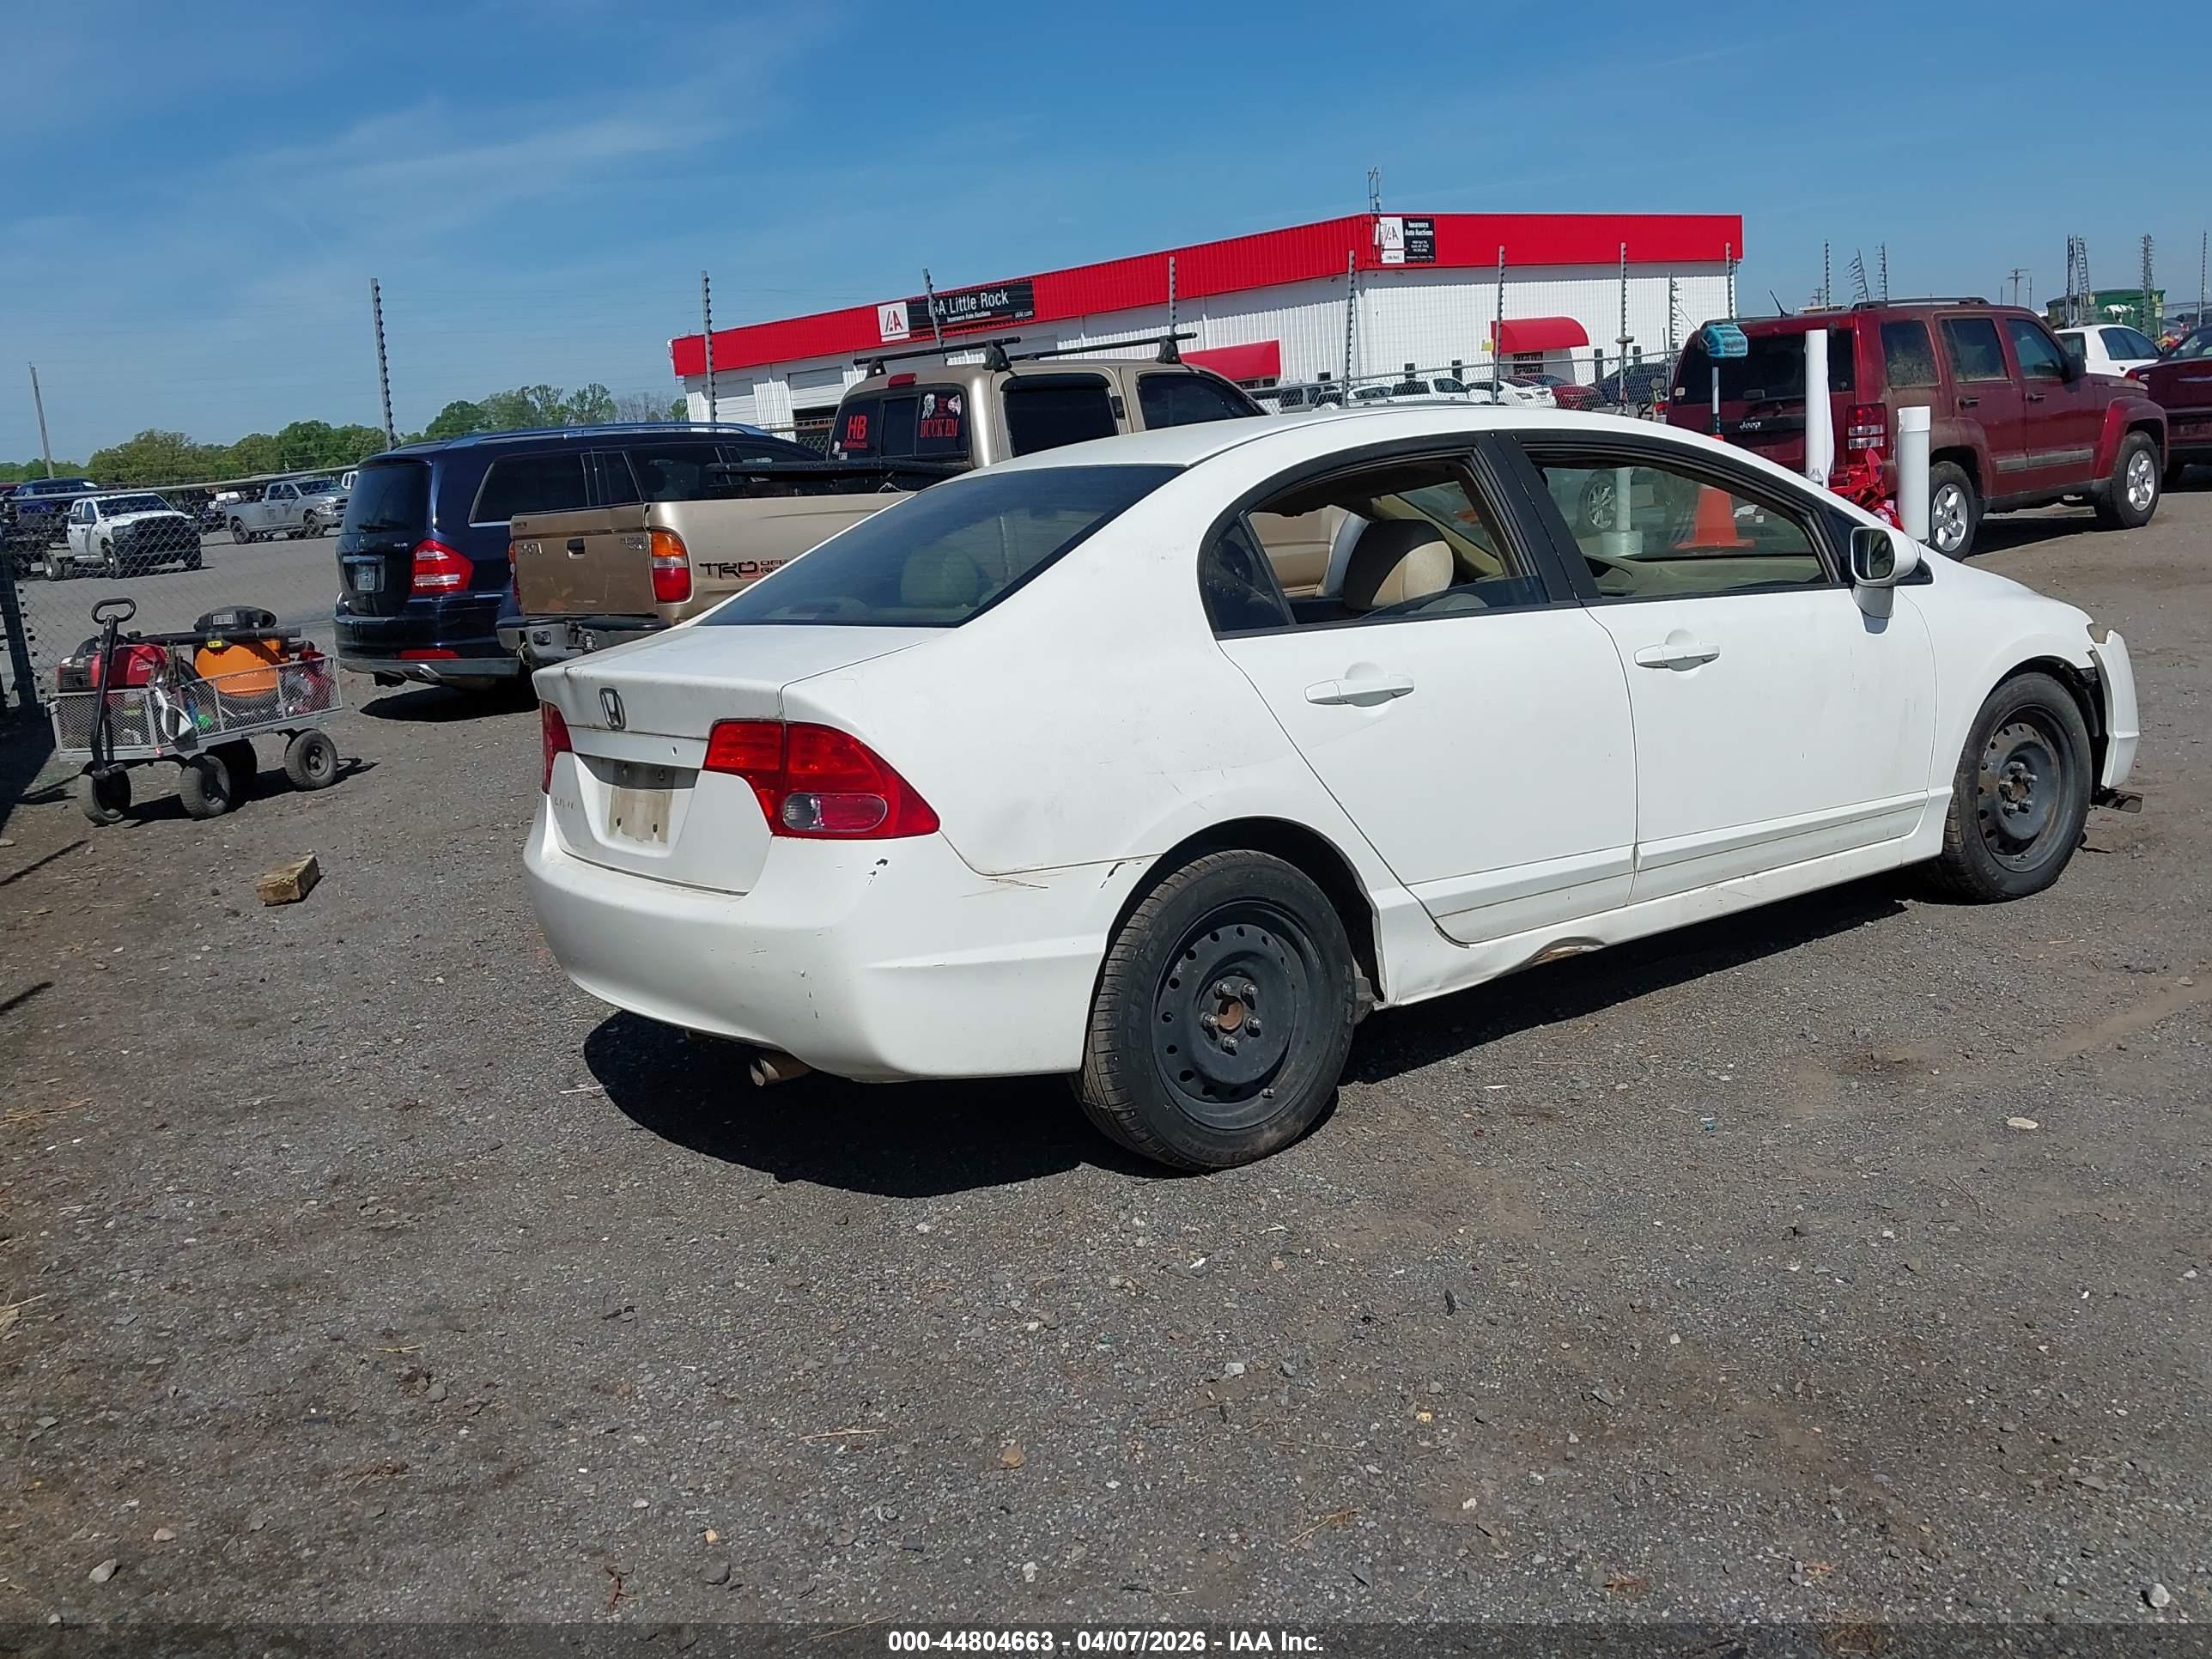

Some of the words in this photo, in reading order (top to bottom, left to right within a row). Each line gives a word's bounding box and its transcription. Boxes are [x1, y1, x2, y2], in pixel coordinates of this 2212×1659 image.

[949, 295, 977, 313] Little
[980, 288, 1010, 308] Rock
[847, 415, 868, 440] HB
[699, 561, 759, 580] TRD
